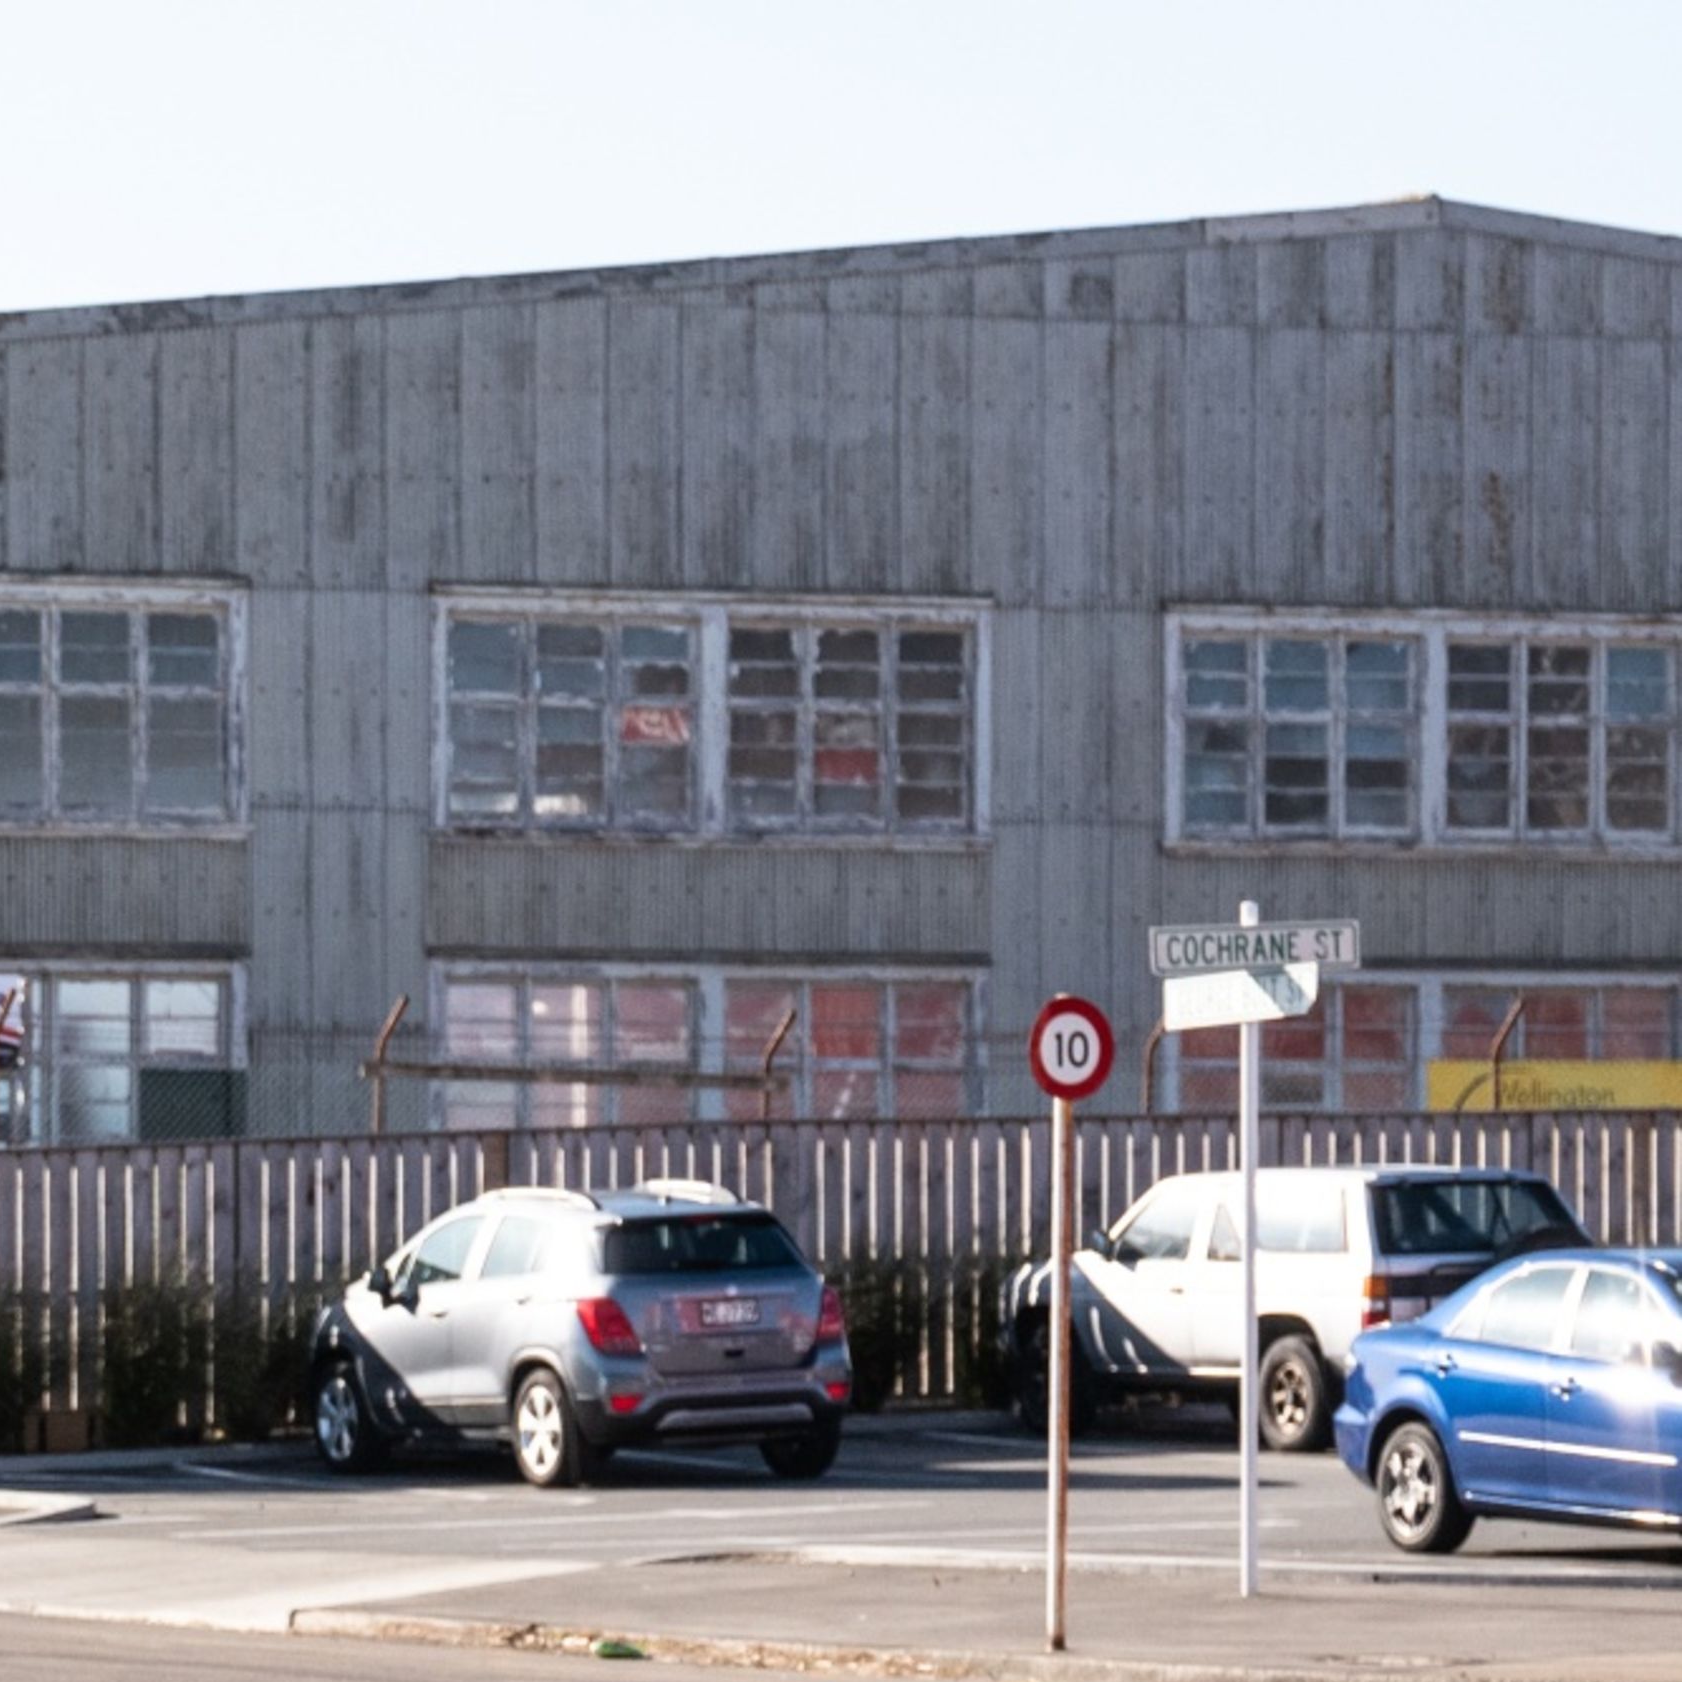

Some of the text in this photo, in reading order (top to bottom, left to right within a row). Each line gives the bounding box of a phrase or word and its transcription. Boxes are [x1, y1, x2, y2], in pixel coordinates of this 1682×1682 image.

[1166, 928, 1345, 966] COCHRANE ST
[1055, 1031, 1090, 1069] 10
